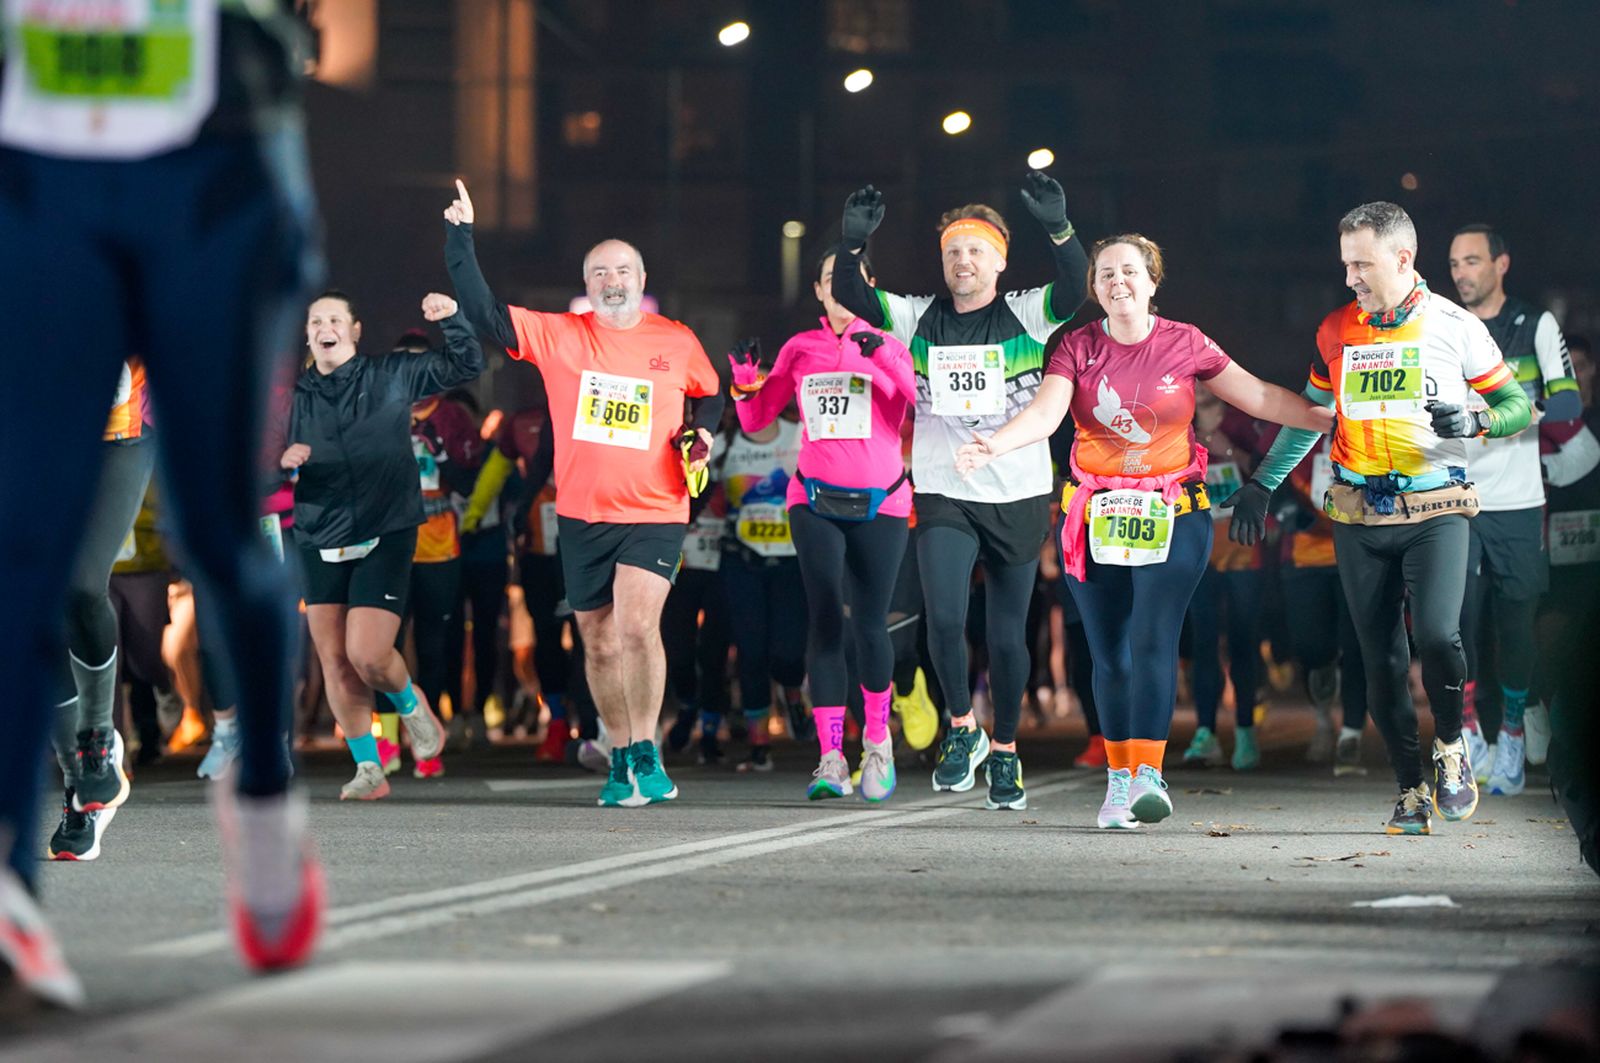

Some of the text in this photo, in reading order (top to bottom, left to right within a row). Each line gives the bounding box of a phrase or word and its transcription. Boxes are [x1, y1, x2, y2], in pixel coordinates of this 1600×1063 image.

[1361, 351, 1394, 361] NOCHE DE
[1351, 361, 1366, 371] SAN
[949, 371, 986, 391] 336
[1360, 369, 1406, 393] 7102
[590, 398, 640, 424] 5666
[818, 396, 849, 415] 337
[1110, 415, 1133, 434] 43
[1100, 507, 1116, 516] SAN
[1109, 498, 1143, 507] NOCHE DE
[1106, 516, 1155, 541] 7503
